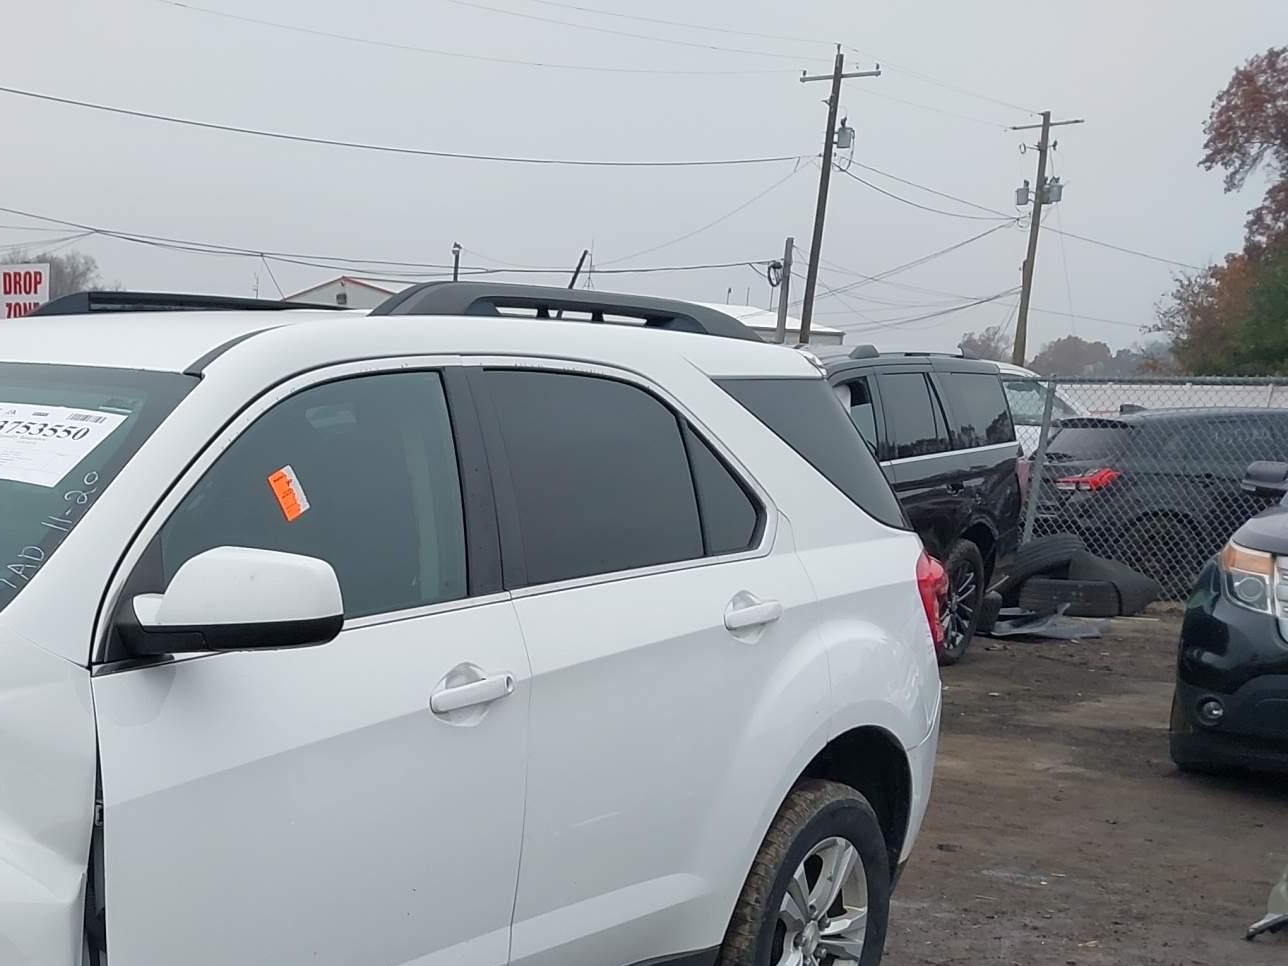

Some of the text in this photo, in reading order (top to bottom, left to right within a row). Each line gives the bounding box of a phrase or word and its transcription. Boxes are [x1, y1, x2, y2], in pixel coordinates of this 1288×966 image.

[3, 271, 42, 295] DROP
[6, 302, 40, 318] ZO
[40, 470, 99, 533] 11-20
